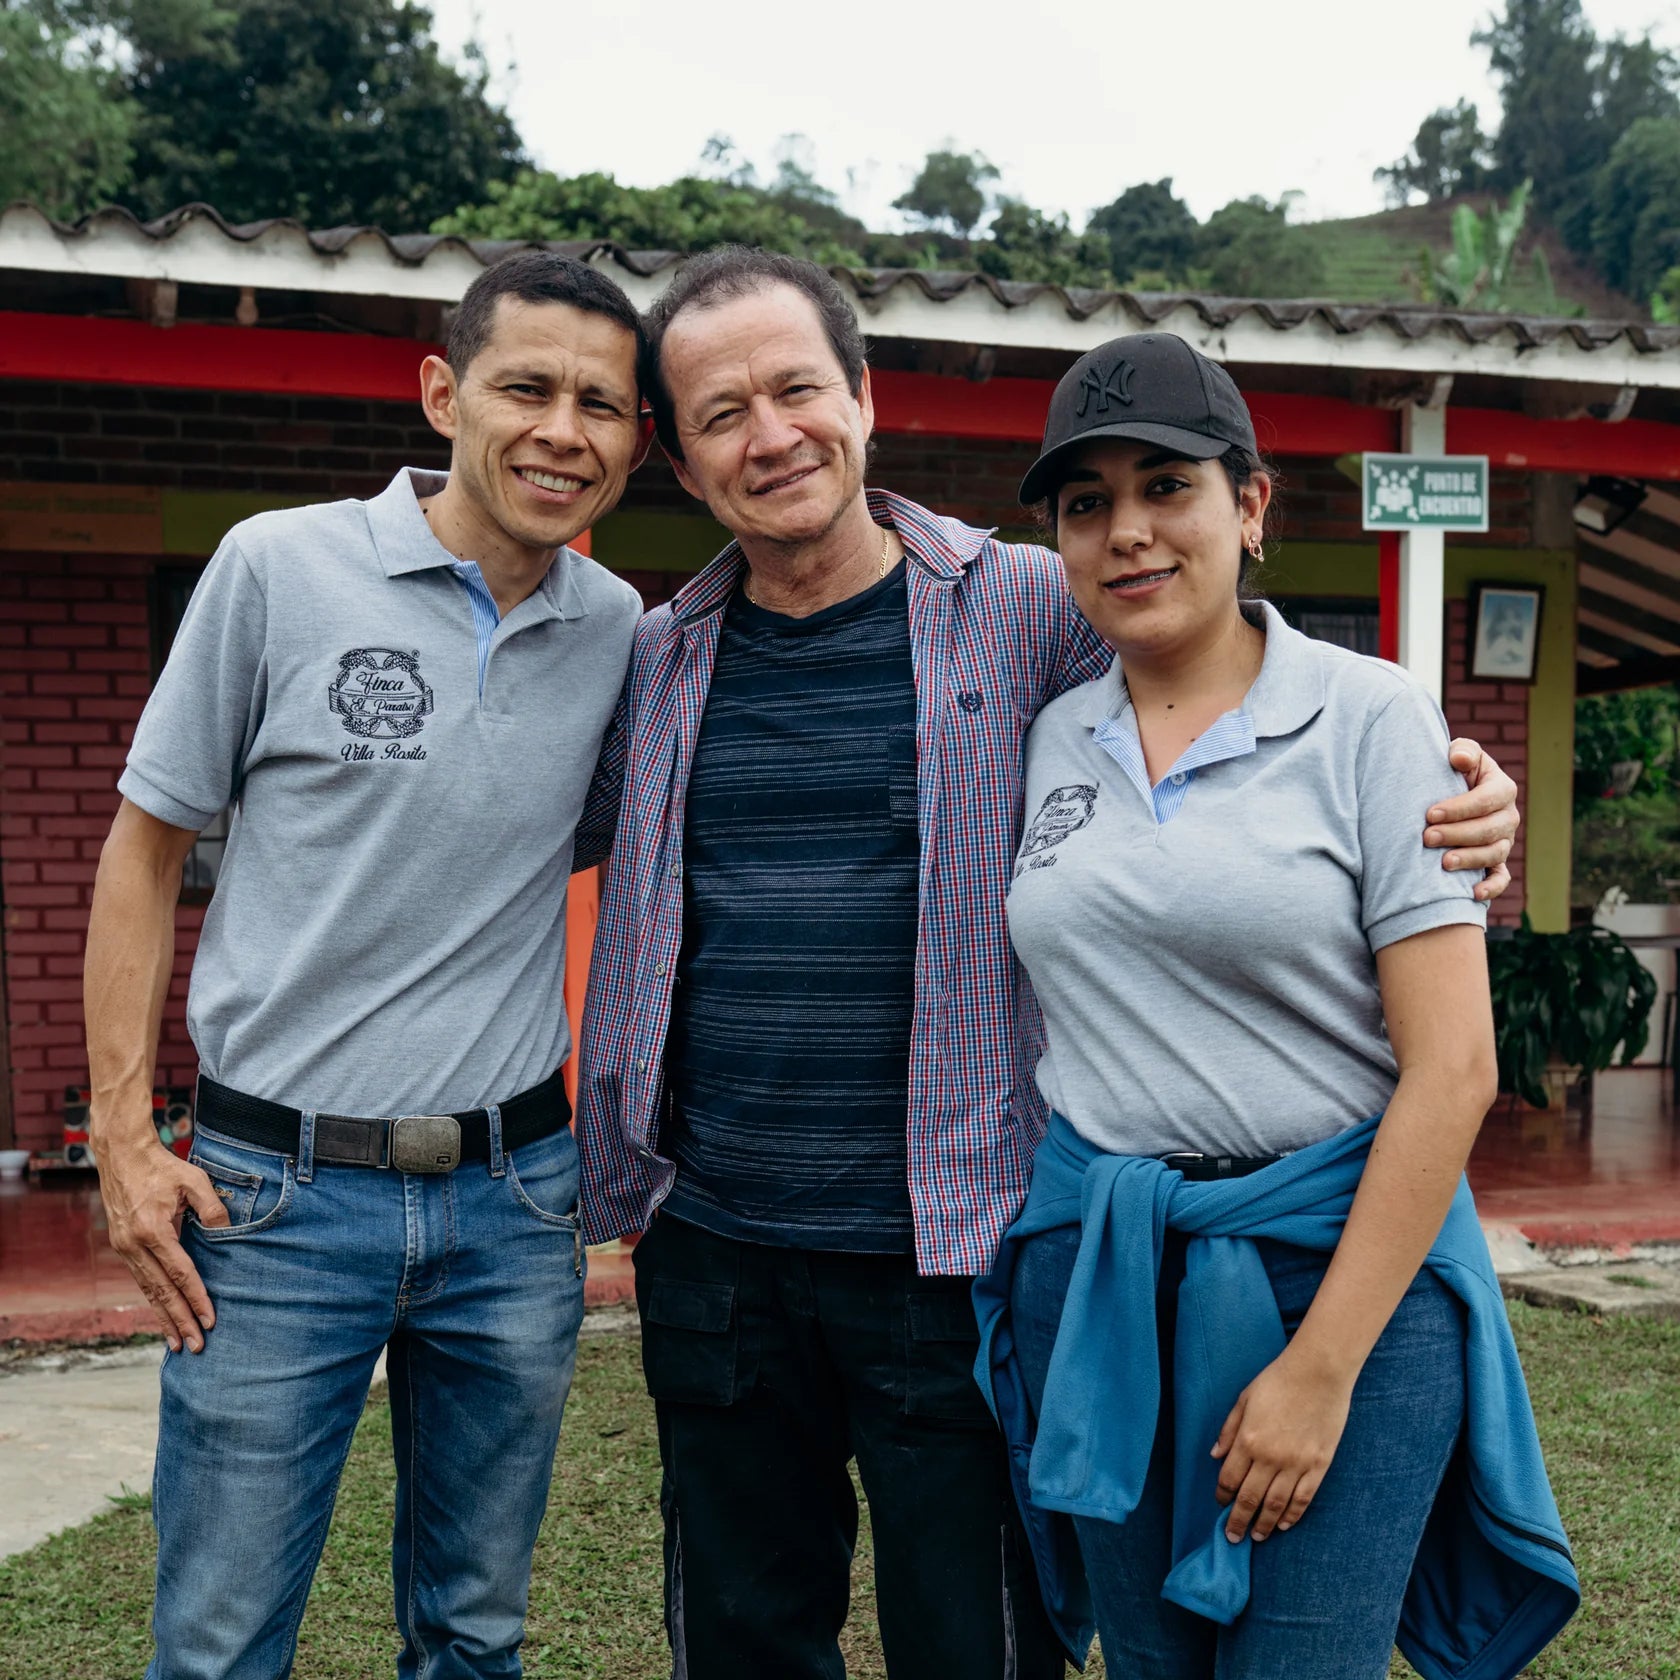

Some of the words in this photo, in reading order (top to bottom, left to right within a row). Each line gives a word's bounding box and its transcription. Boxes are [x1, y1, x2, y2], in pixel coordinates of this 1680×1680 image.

[1076, 359, 1136, 417] NY
[1423, 471, 1460, 493] PUNTO
[1461, 472, 1478, 493] DE
[1418, 495, 1483, 516] ENCUENTRO
[356, 672, 404, 695] Finca
[340, 742, 375, 762] Villa
[380, 742, 428, 760] Rosita
